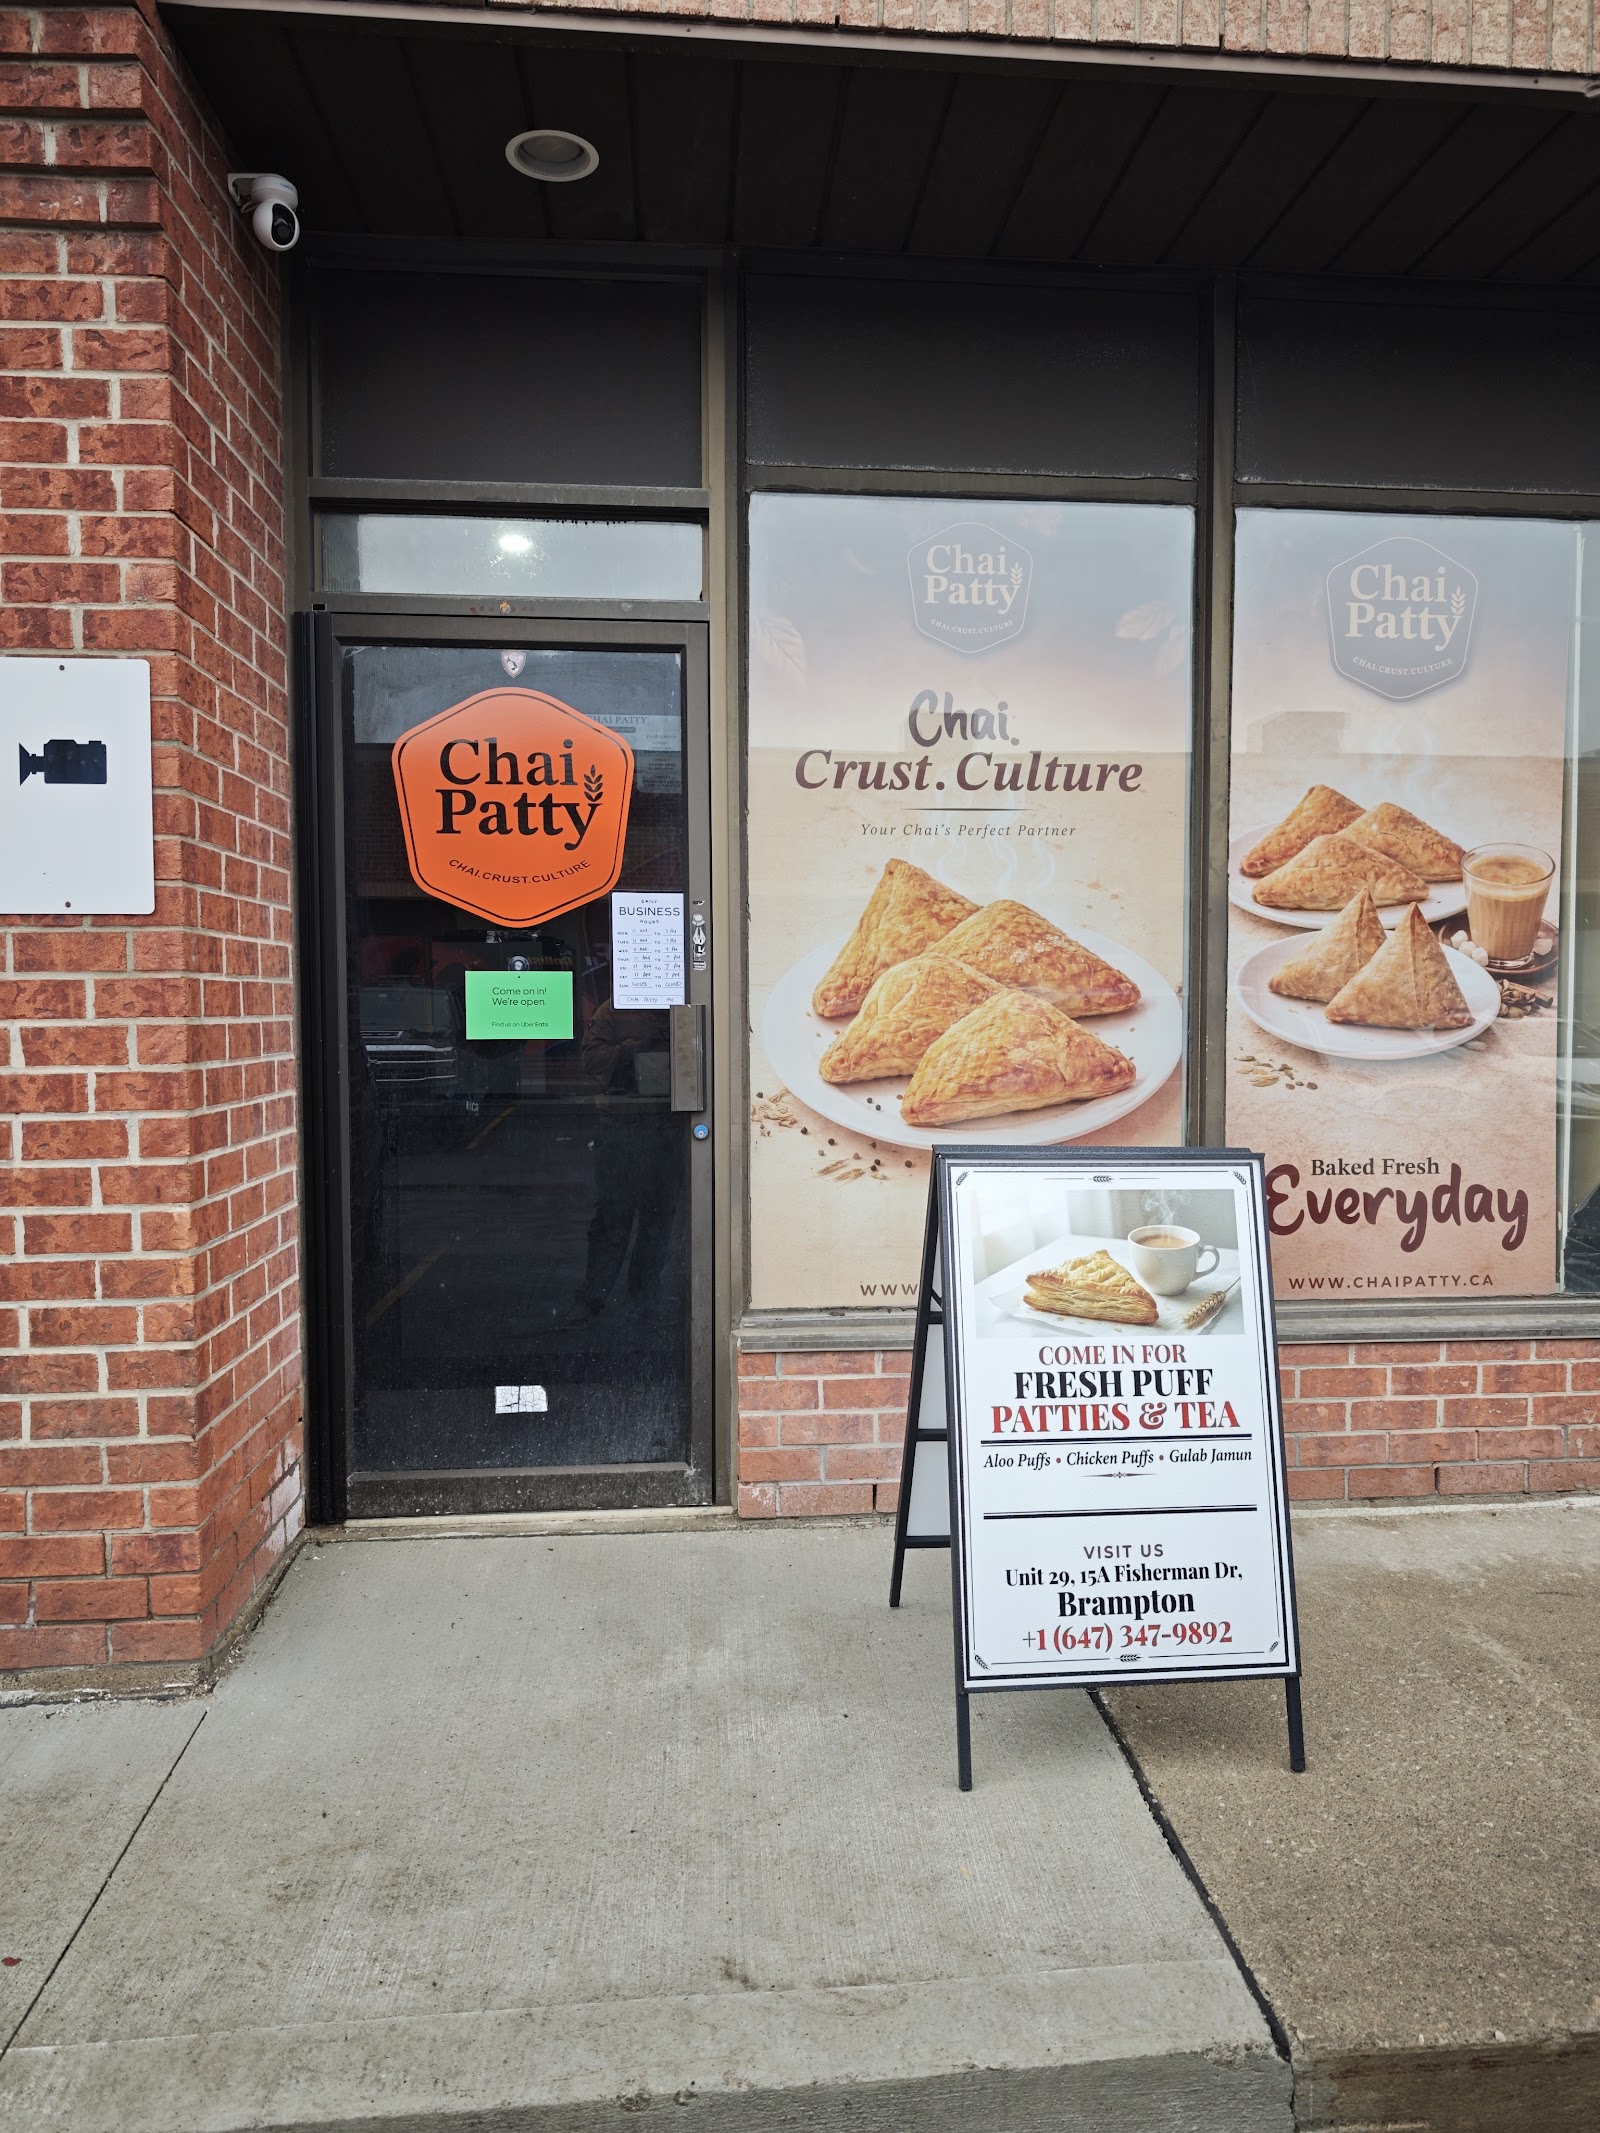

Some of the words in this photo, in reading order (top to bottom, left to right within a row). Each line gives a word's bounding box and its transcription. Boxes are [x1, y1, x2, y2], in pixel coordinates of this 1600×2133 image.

[927, 544, 1008, 575] Chai
[924, 575, 1020, 614] Patty
[1350, 564, 1448, 602] Chai
[1345, 602, 1462, 652] Patty
[590, 715, 610, 723] HAI
[616, 716, 647, 724] PATTY
[908, 689, 1020, 747] Chai.
[440, 737, 578, 785] Chai
[796, 749, 944, 791] Crust.
[957, 751, 1143, 792] Culture
[435, 789, 603, 850] Patty
[861, 824, 896, 836] Your
[903, 823, 951, 836] Chai's
[958, 823, 1010, 840] Perfect
[1018, 823, 1077, 836] Partner
[449, 859, 591, 884] CHAI.CRUST.CULTURE
[619, 906, 681, 916] BUSINESS
[492, 987, 521, 995] Come
[523, 987, 535, 995] on
[536, 987, 547, 995] in!
[492, 997, 519, 1006] We're
[520, 998, 547, 1007] open.
[1311, 1158, 1375, 1176] Baked
[1382, 1157, 1440, 1175] Fresh
[1266, 1163, 1529, 1252] Everyday
[1289, 1274, 1494, 1289] WWW.CHAIPATTY.CA
[1039, 1346, 1106, 1366] COME
[1112, 1345, 1135, 1364] IN
[1141, 1344, 1187, 1363] FOR
[1014, 1370, 1123, 1399] FRESH
[1132, 1369, 1213, 1397] PUFF
[991, 1402, 1131, 1433] PATTIES
[1139, 1402, 1167, 1430] &
[1175, 1401, 1241, 1429] TEA
[984, 1454, 1014, 1468] Aloo
[1018, 1453, 1051, 1470] Puffs
[1067, 1451, 1118, 1466] Chicken
[1122, 1449, 1154, 1467] Puffs
[1170, 1448, 1208, 1463] Gulab
[1211, 1449, 1252, 1464] Jamun
[1083, 1545, 1132, 1559] VISIT
[1140, 1544, 1164, 1557] US
[1005, 1567, 1044, 1586] Unit
[1049, 1571, 1075, 1587] 29,
[1080, 1566, 1111, 1585] 15A
[1114, 1563, 1210, 1583] Fisherman
[1214, 1561, 1243, 1581] Dr,
[1057, 1590, 1195, 1621] Brampton
[1022, 1628, 1048, 1650] +1
[1053, 1622, 1113, 1655] (647)
[1120, 1621, 1233, 1648] 347-9892
